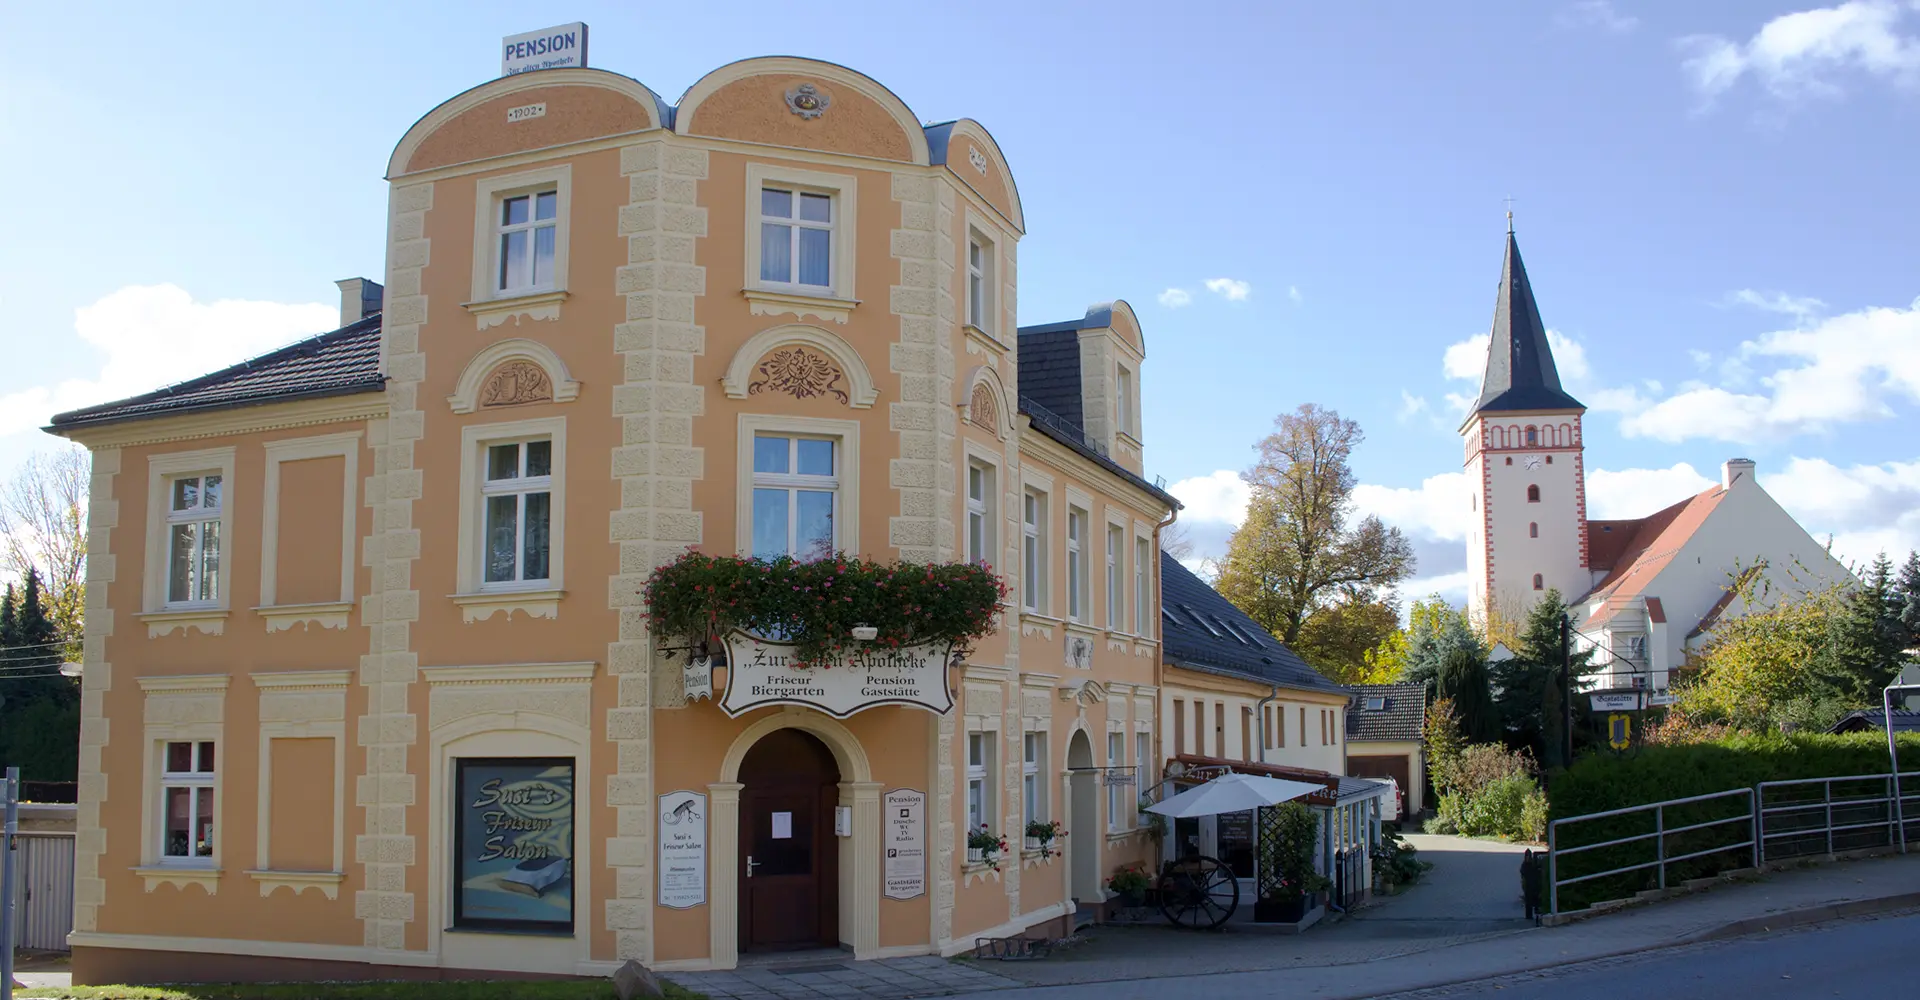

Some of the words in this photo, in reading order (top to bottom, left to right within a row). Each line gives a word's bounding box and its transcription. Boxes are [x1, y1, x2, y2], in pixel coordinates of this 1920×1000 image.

[505, 32, 576, 61] PENSION
[685, 671, 708, 688] Pension
[766, 675, 812, 685] Friseur
[865, 675, 915, 685] Pension
[751, 685, 825, 698] Biergarten
[861, 686, 920, 697] Gaststätte
[482, 811, 553, 835] Friseur
[478, 836, 549, 862] Salon
